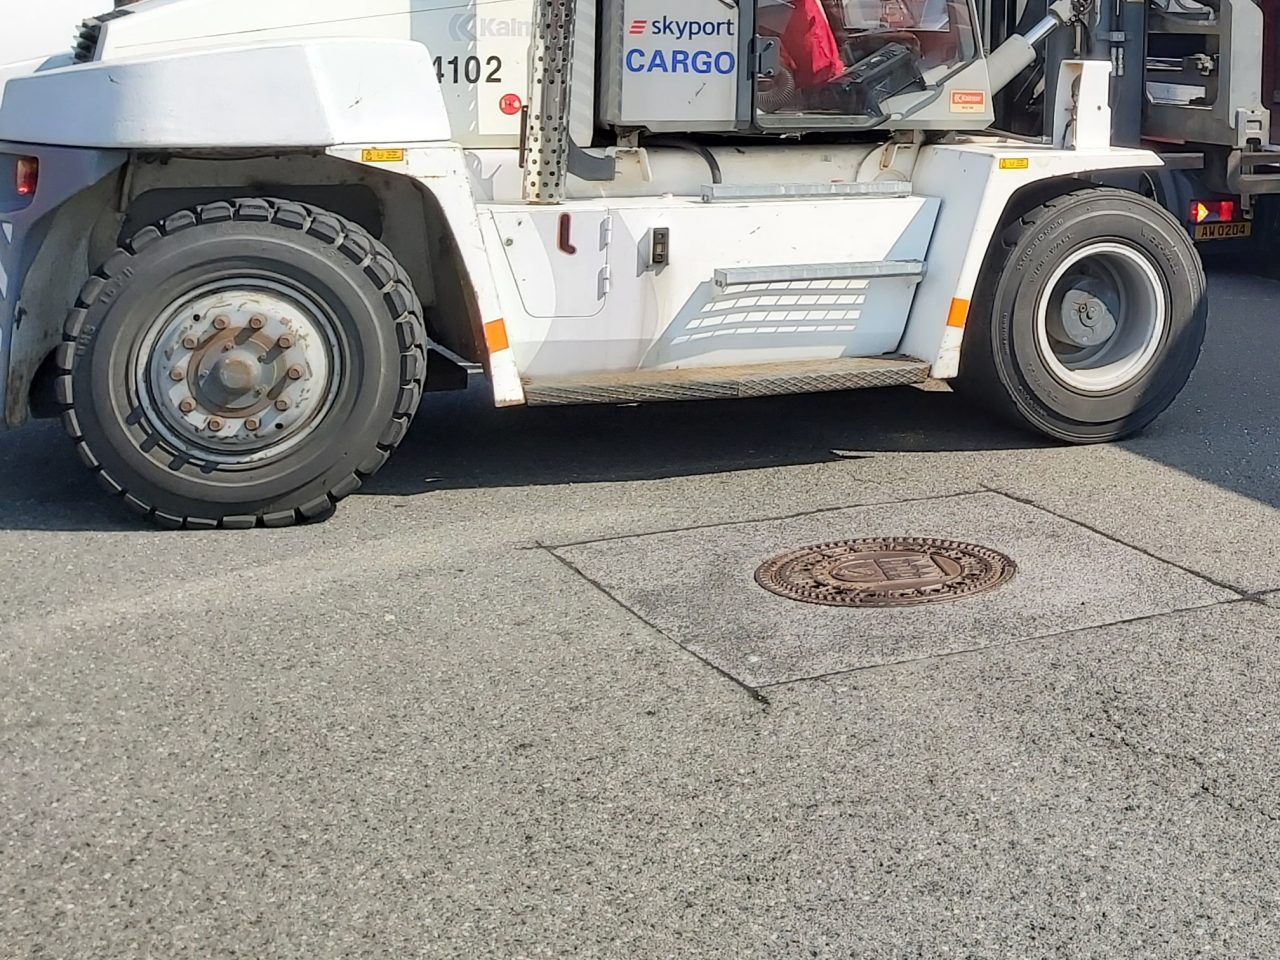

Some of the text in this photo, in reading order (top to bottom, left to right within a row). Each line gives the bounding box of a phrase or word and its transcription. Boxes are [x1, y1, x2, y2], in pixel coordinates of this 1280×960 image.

[651, 15, 735, 40] skyport
[433, 55, 502, 84] 4102
[626, 49, 735, 74] CARGO
[1201, 223, 1246, 238] AW 0204
